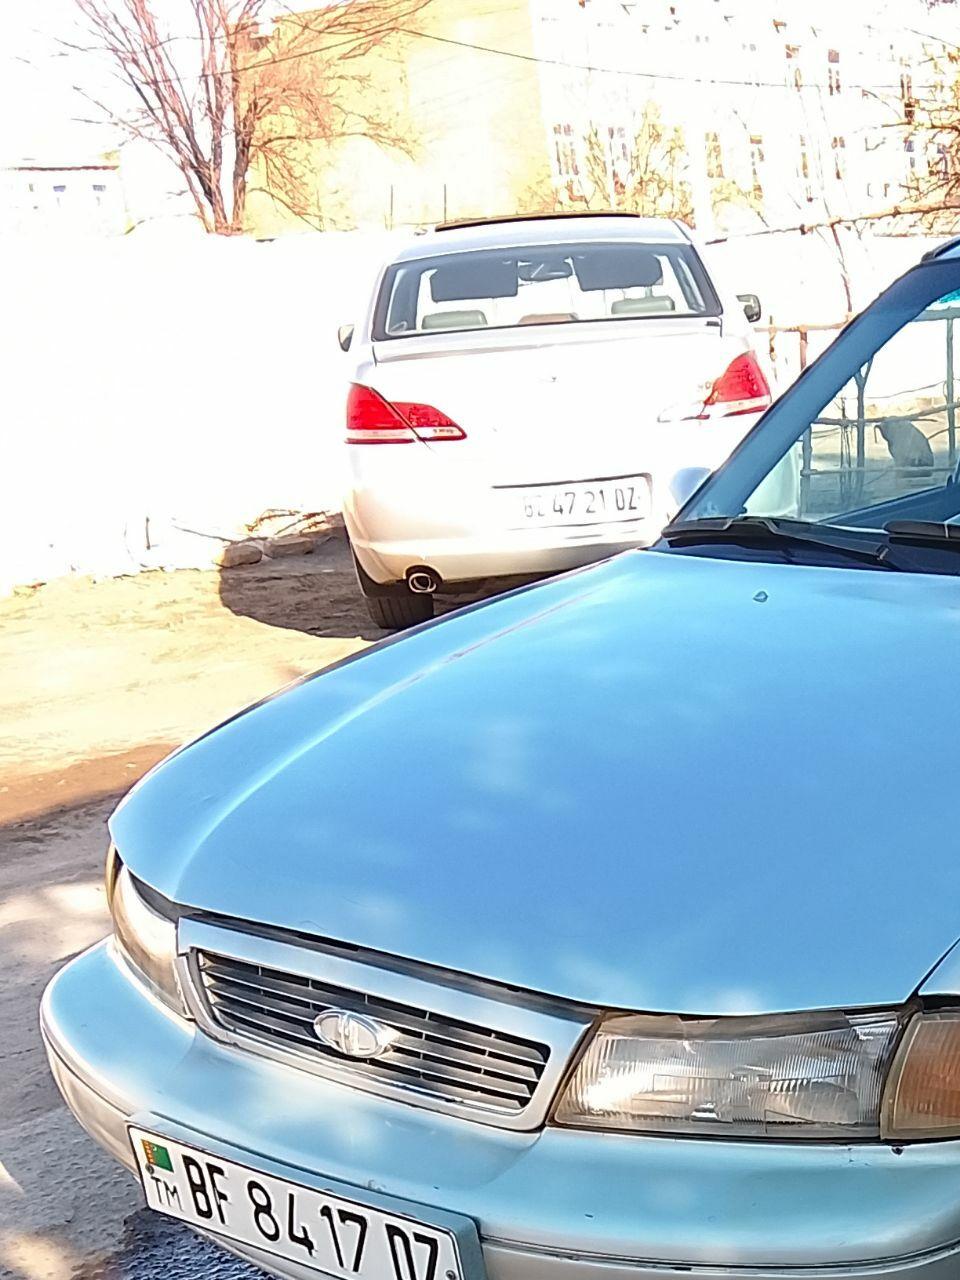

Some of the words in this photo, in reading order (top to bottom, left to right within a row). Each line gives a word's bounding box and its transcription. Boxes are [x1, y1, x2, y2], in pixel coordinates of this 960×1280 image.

[552, 492, 576, 515] 47
[584, 489, 606, 514] 21
[151, 1175, 183, 1211] TM
[181, 1154, 229, 1225] BF
[247, 1180, 368, 1272] 8417
